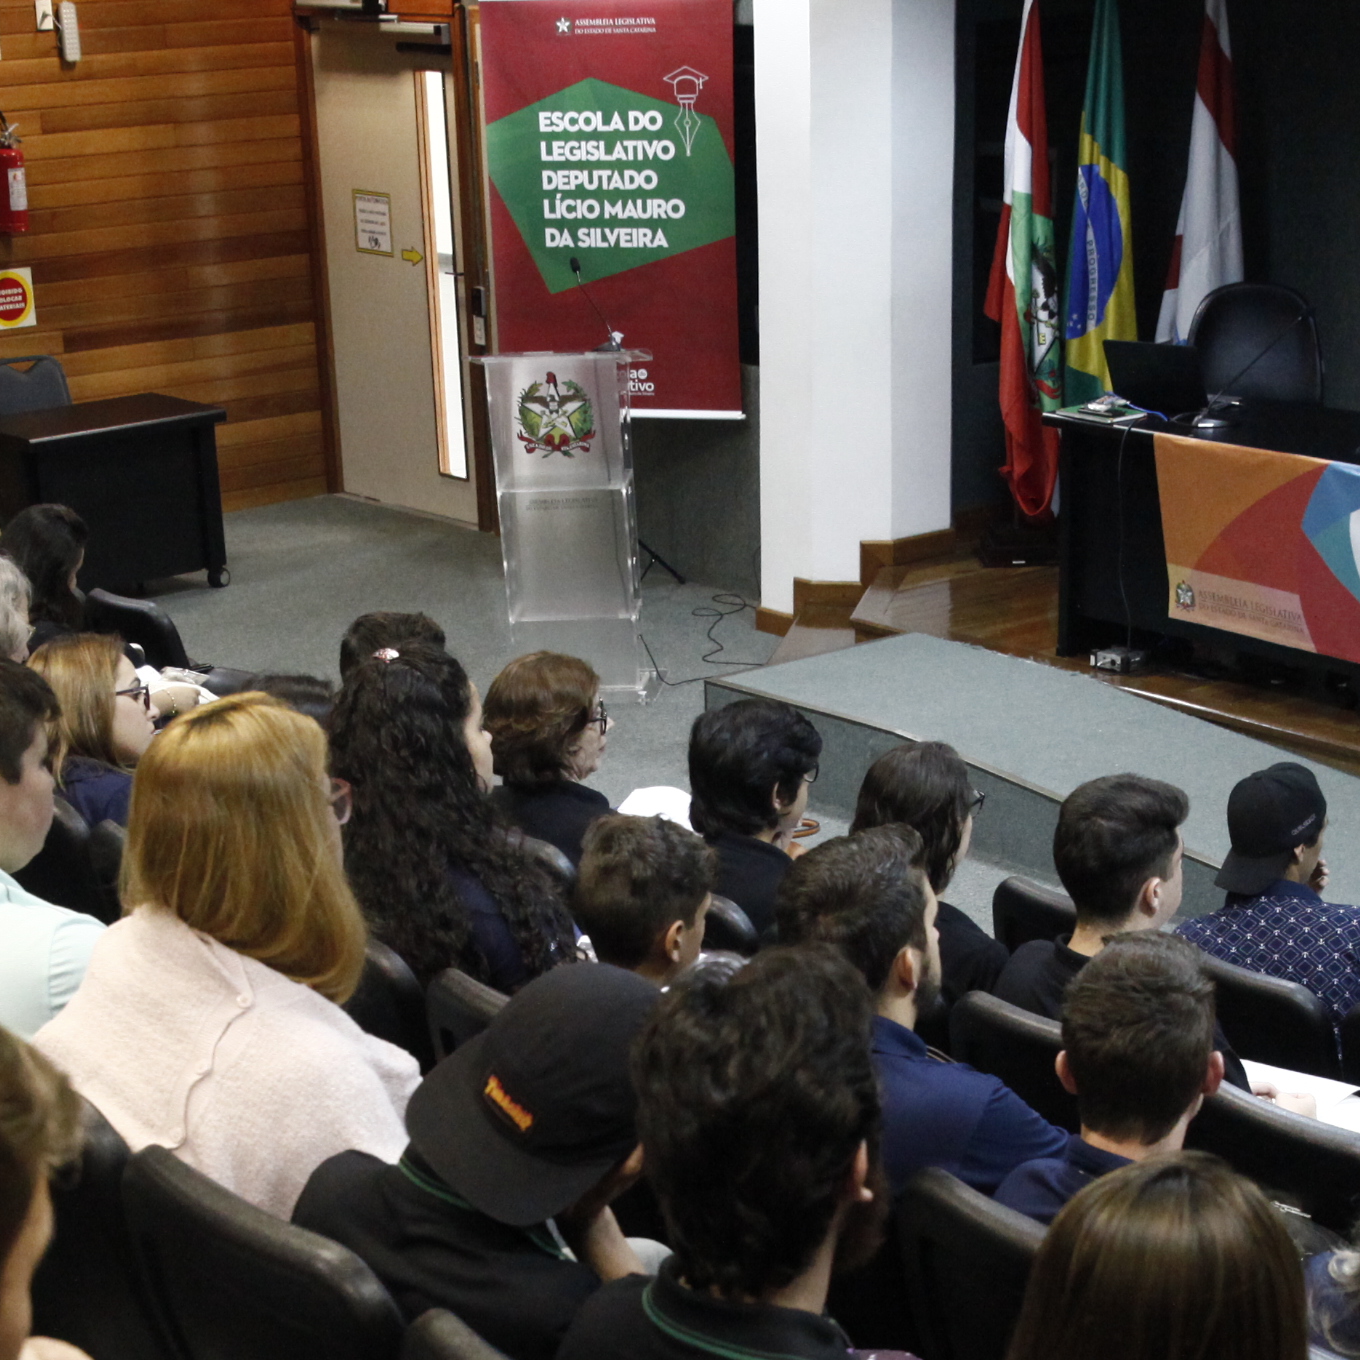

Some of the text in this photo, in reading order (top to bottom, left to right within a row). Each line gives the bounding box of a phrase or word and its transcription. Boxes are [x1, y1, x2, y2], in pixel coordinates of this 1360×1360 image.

[574, 17, 656, 26] ASSEMBLEIA LEGISLATIVA
[538, 110, 663, 132] ESCOLA DO
[540, 139, 676, 161] LEGISLATIVO
[542, 169, 658, 190] DEPUTADO
[543, 193, 686, 219] LÍCIO MAURO
[545, 227, 669, 248] DA SILVEIRA
